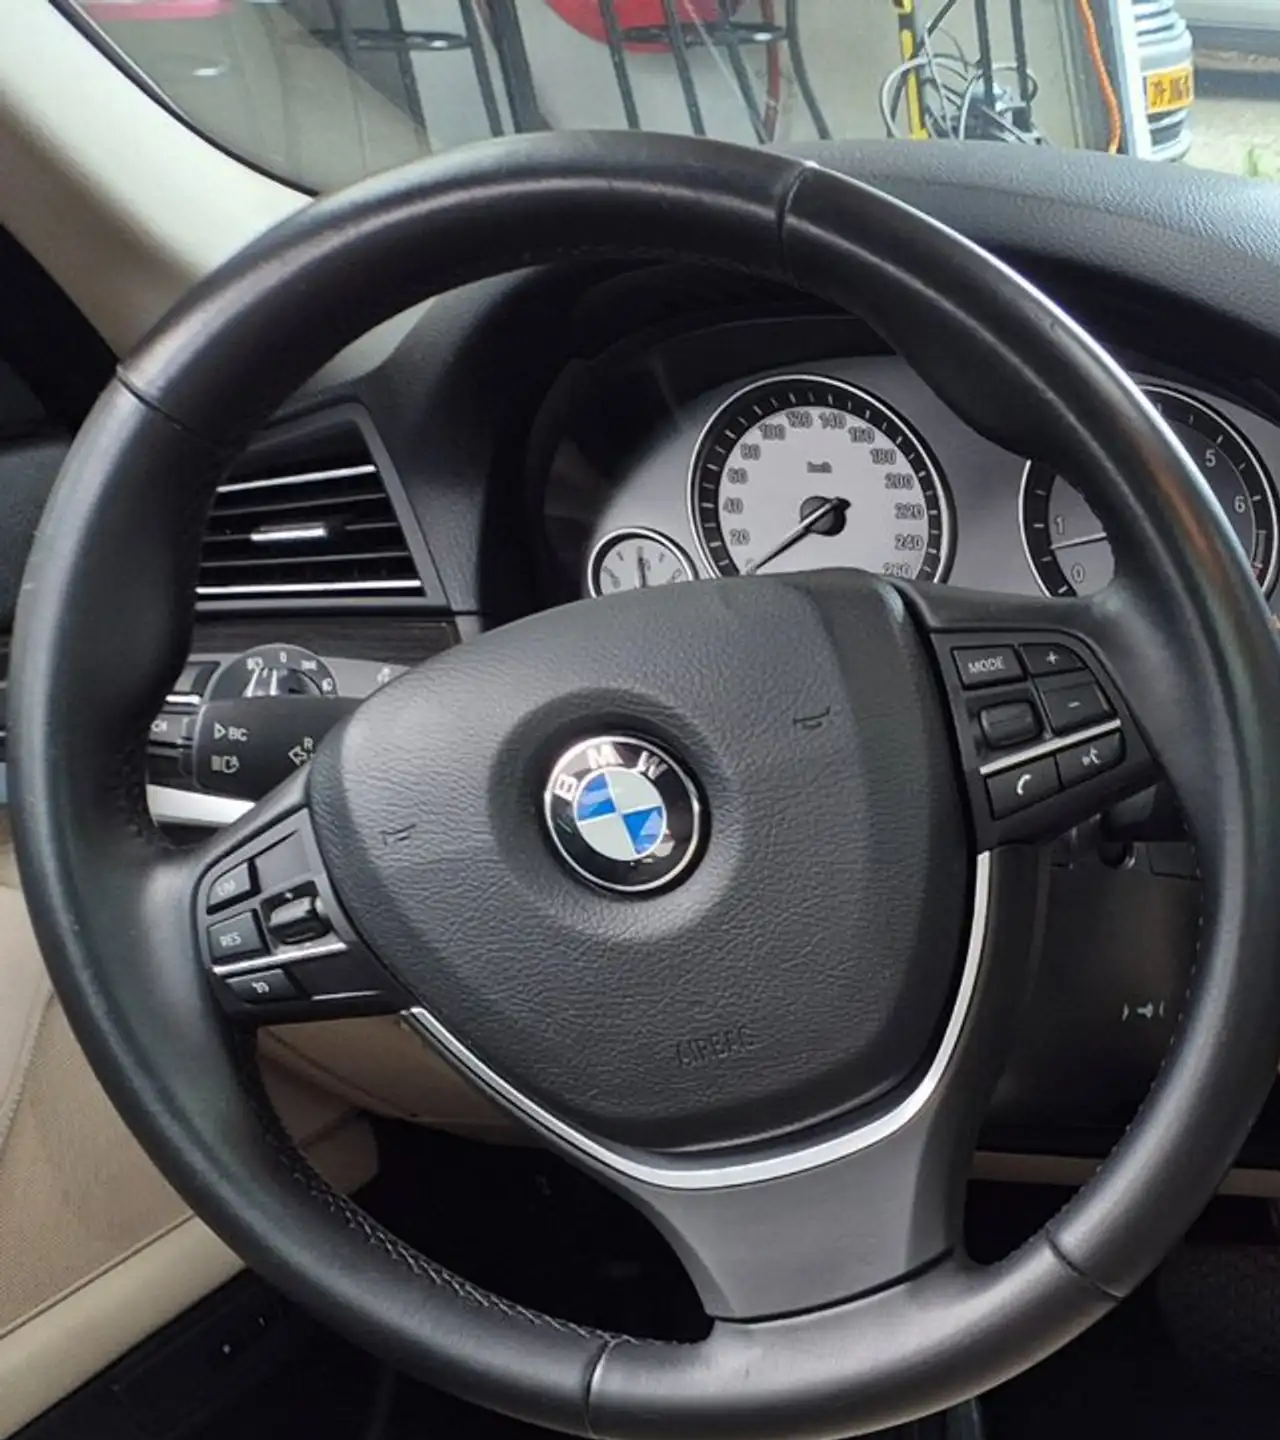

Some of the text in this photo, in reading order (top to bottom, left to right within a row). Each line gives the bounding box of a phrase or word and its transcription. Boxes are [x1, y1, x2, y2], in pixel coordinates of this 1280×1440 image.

[786, 411, 813, 428] 120
[818, 414, 847, 429] 140
[759, 424, 786, 440] 100
[1204, 451, 1216, 467] 5
[884, 474, 915, 490] 200
[895, 503, 925, 520] 220
[1234, 496, 1246, 513] 6
[1054, 517, 1065, 535] 1
[729, 530, 750, 545] 20
[895, 535, 923, 550] 240
[1071, 565, 1085, 583] 0
[967, 656, 1005, 674] MODE
[303, 737, 314, 750] R
[554, 742, 669, 801] BMW
